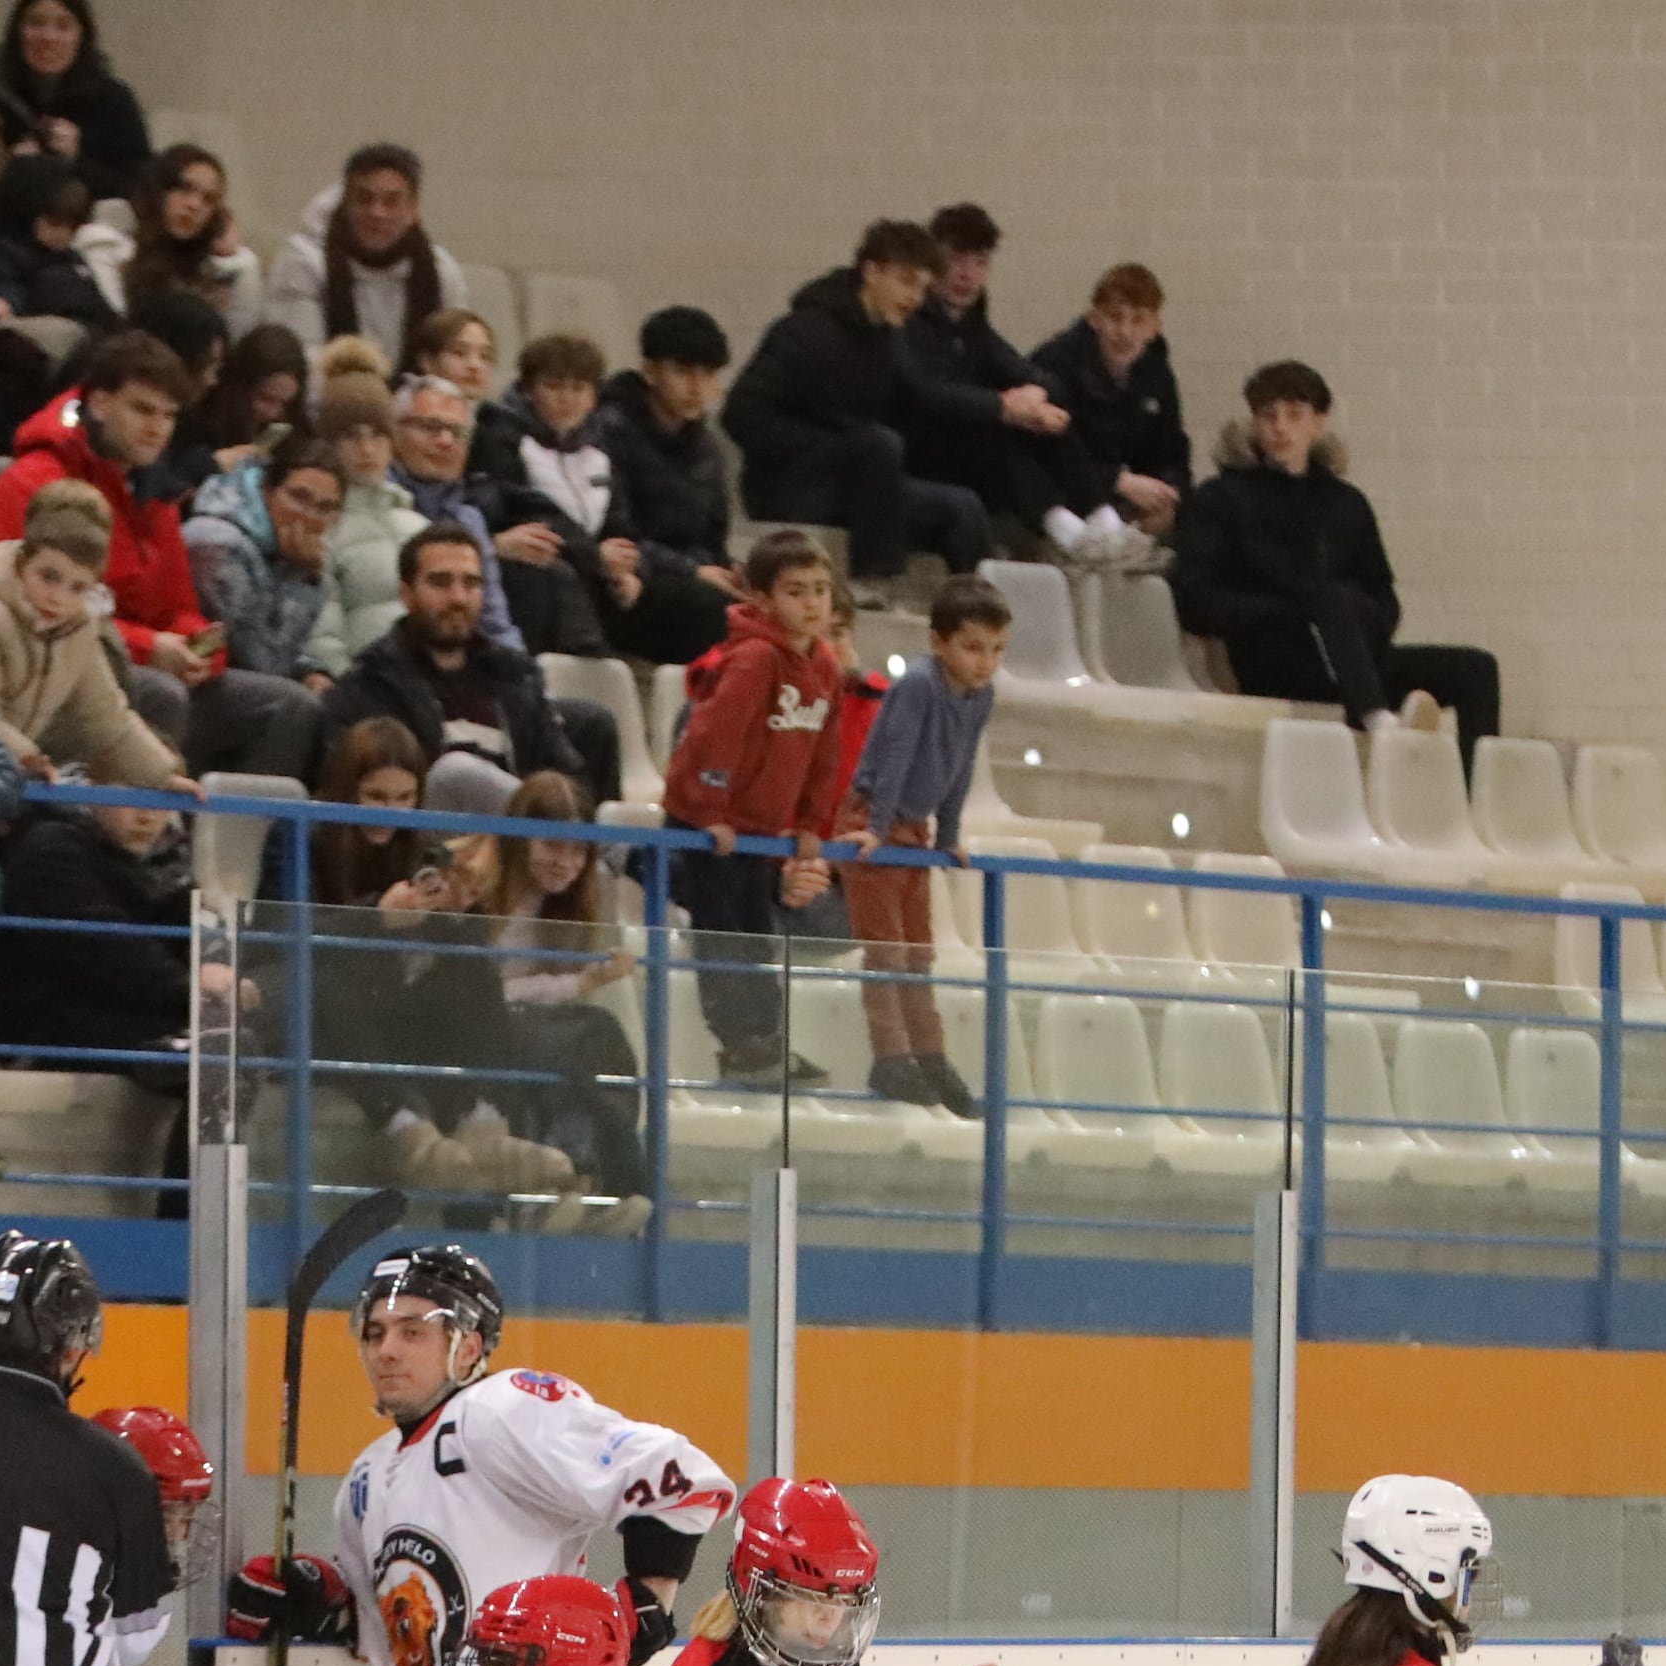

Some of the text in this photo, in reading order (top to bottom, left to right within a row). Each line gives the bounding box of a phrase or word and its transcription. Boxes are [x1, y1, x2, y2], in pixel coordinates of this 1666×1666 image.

[434, 1420, 466, 1477] C
[835, 1568, 866, 1578] CCM
[556, 1631, 587, 1645] CCM
